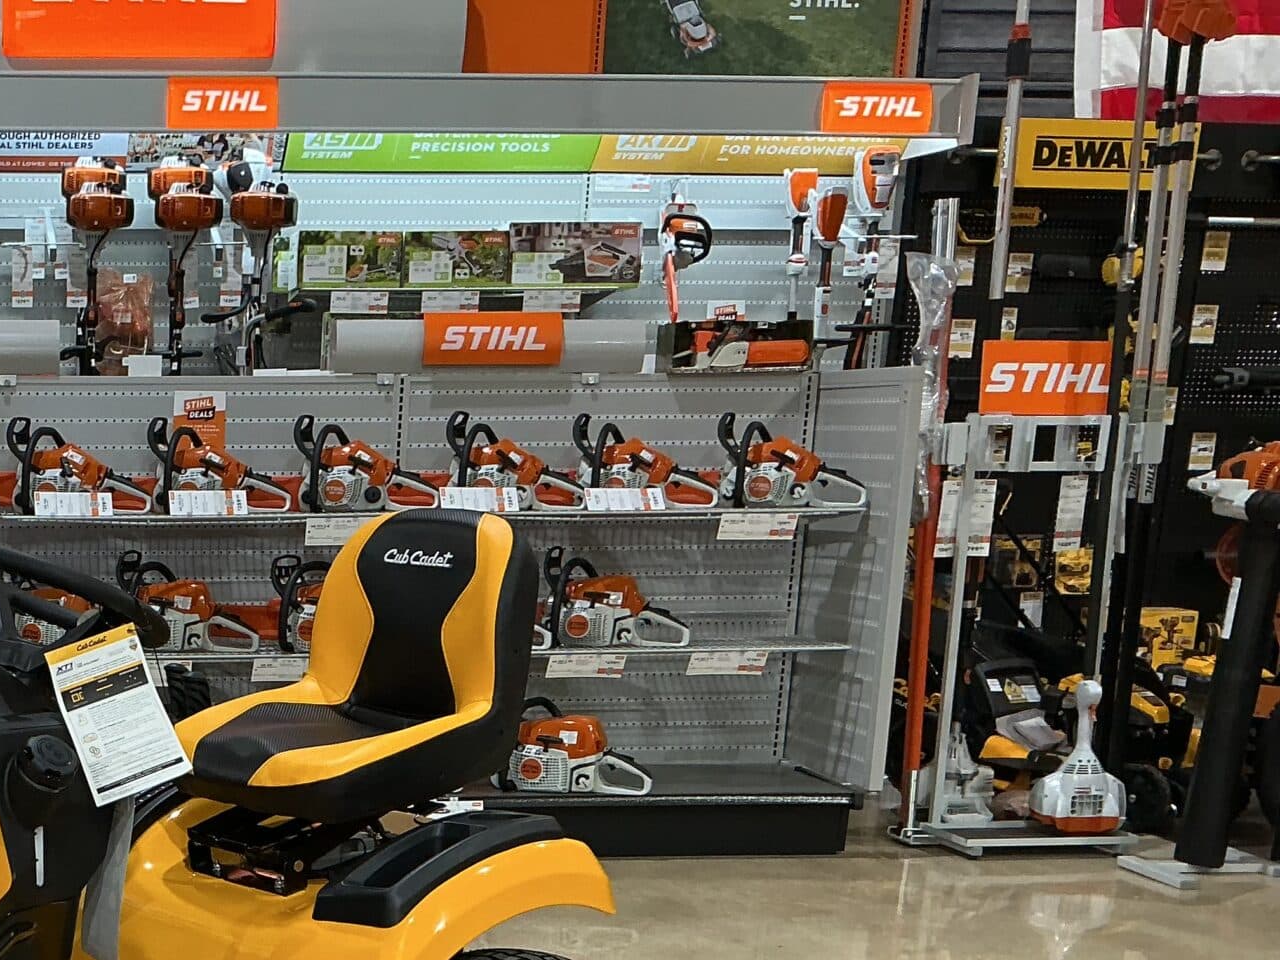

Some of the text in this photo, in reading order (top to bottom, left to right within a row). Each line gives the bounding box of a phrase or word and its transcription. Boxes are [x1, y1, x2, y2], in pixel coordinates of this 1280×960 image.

[181, 90, 268, 112] STIHL
[837, 96, 923, 117] STIHL
[33, 131, 101, 141] AUTHORIZED
[15, 142, 44, 150] STIHL
[47, 142, 94, 150] DEALERS
[411, 141, 551, 152] PRECISION TOOLS
[720, 144, 752, 155] FOR
[301, 151, 353, 159] SYSTEM
[612, 152, 665, 160] SYSTEM
[440, 326, 546, 351] STIHL
[984, 362, 1110, 393] STIHL
[185, 399, 212, 410] STIHL
[189, 410, 214, 418] DEALS
[384, 548, 455, 569] Cub Cadet
